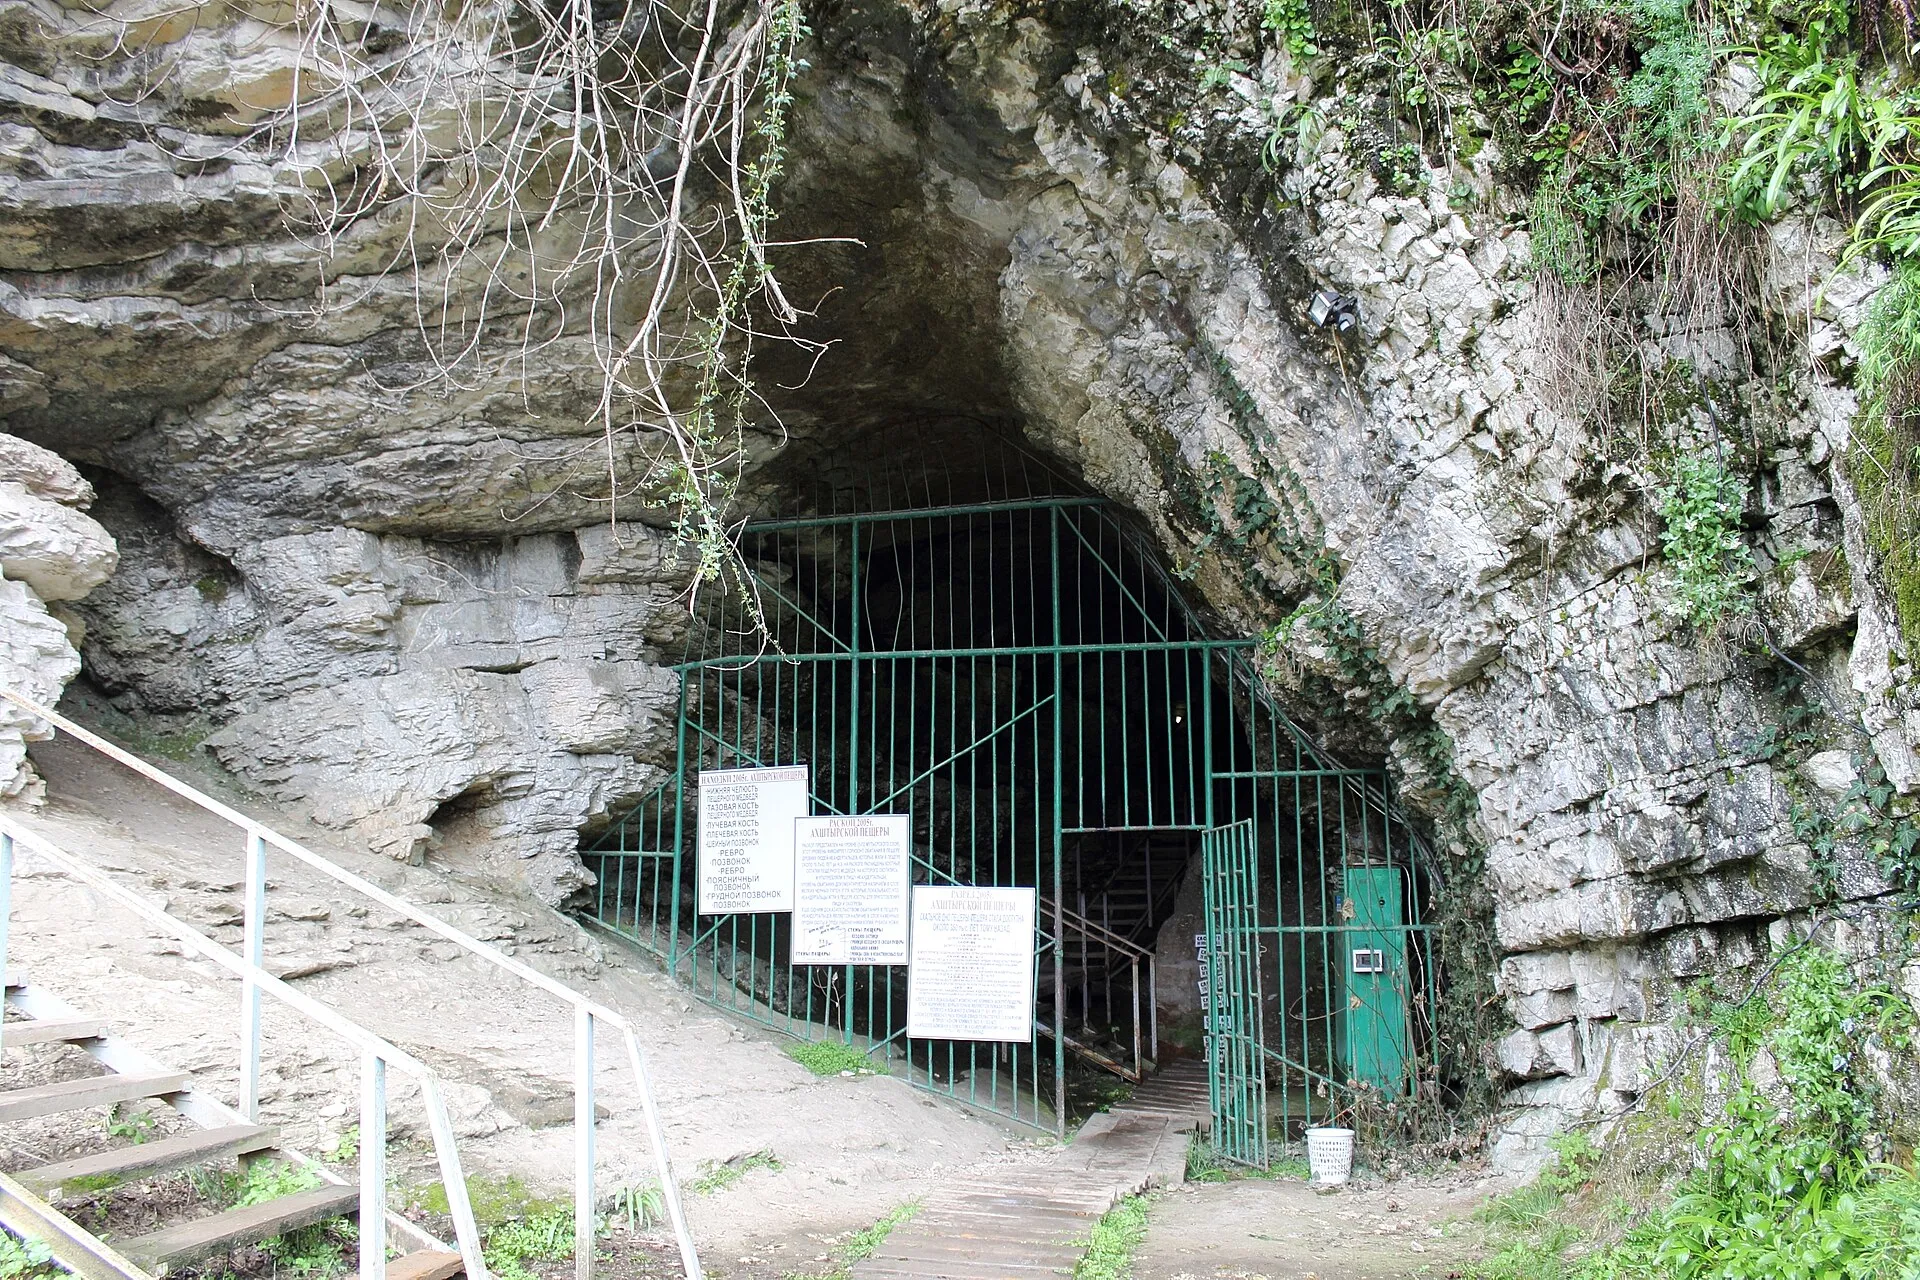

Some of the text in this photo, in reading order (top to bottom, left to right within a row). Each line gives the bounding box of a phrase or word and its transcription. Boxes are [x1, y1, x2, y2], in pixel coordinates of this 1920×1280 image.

[702, 776, 731, 784] НАХОДКИ
[830, 819, 856, 827] РАСКОП
[860, 827, 890, 836] ПЕЩЕРЫ
[714, 883, 750, 891] ПОЗВОНОК
[742, 890, 781, 898] ПОЗВОНОК
